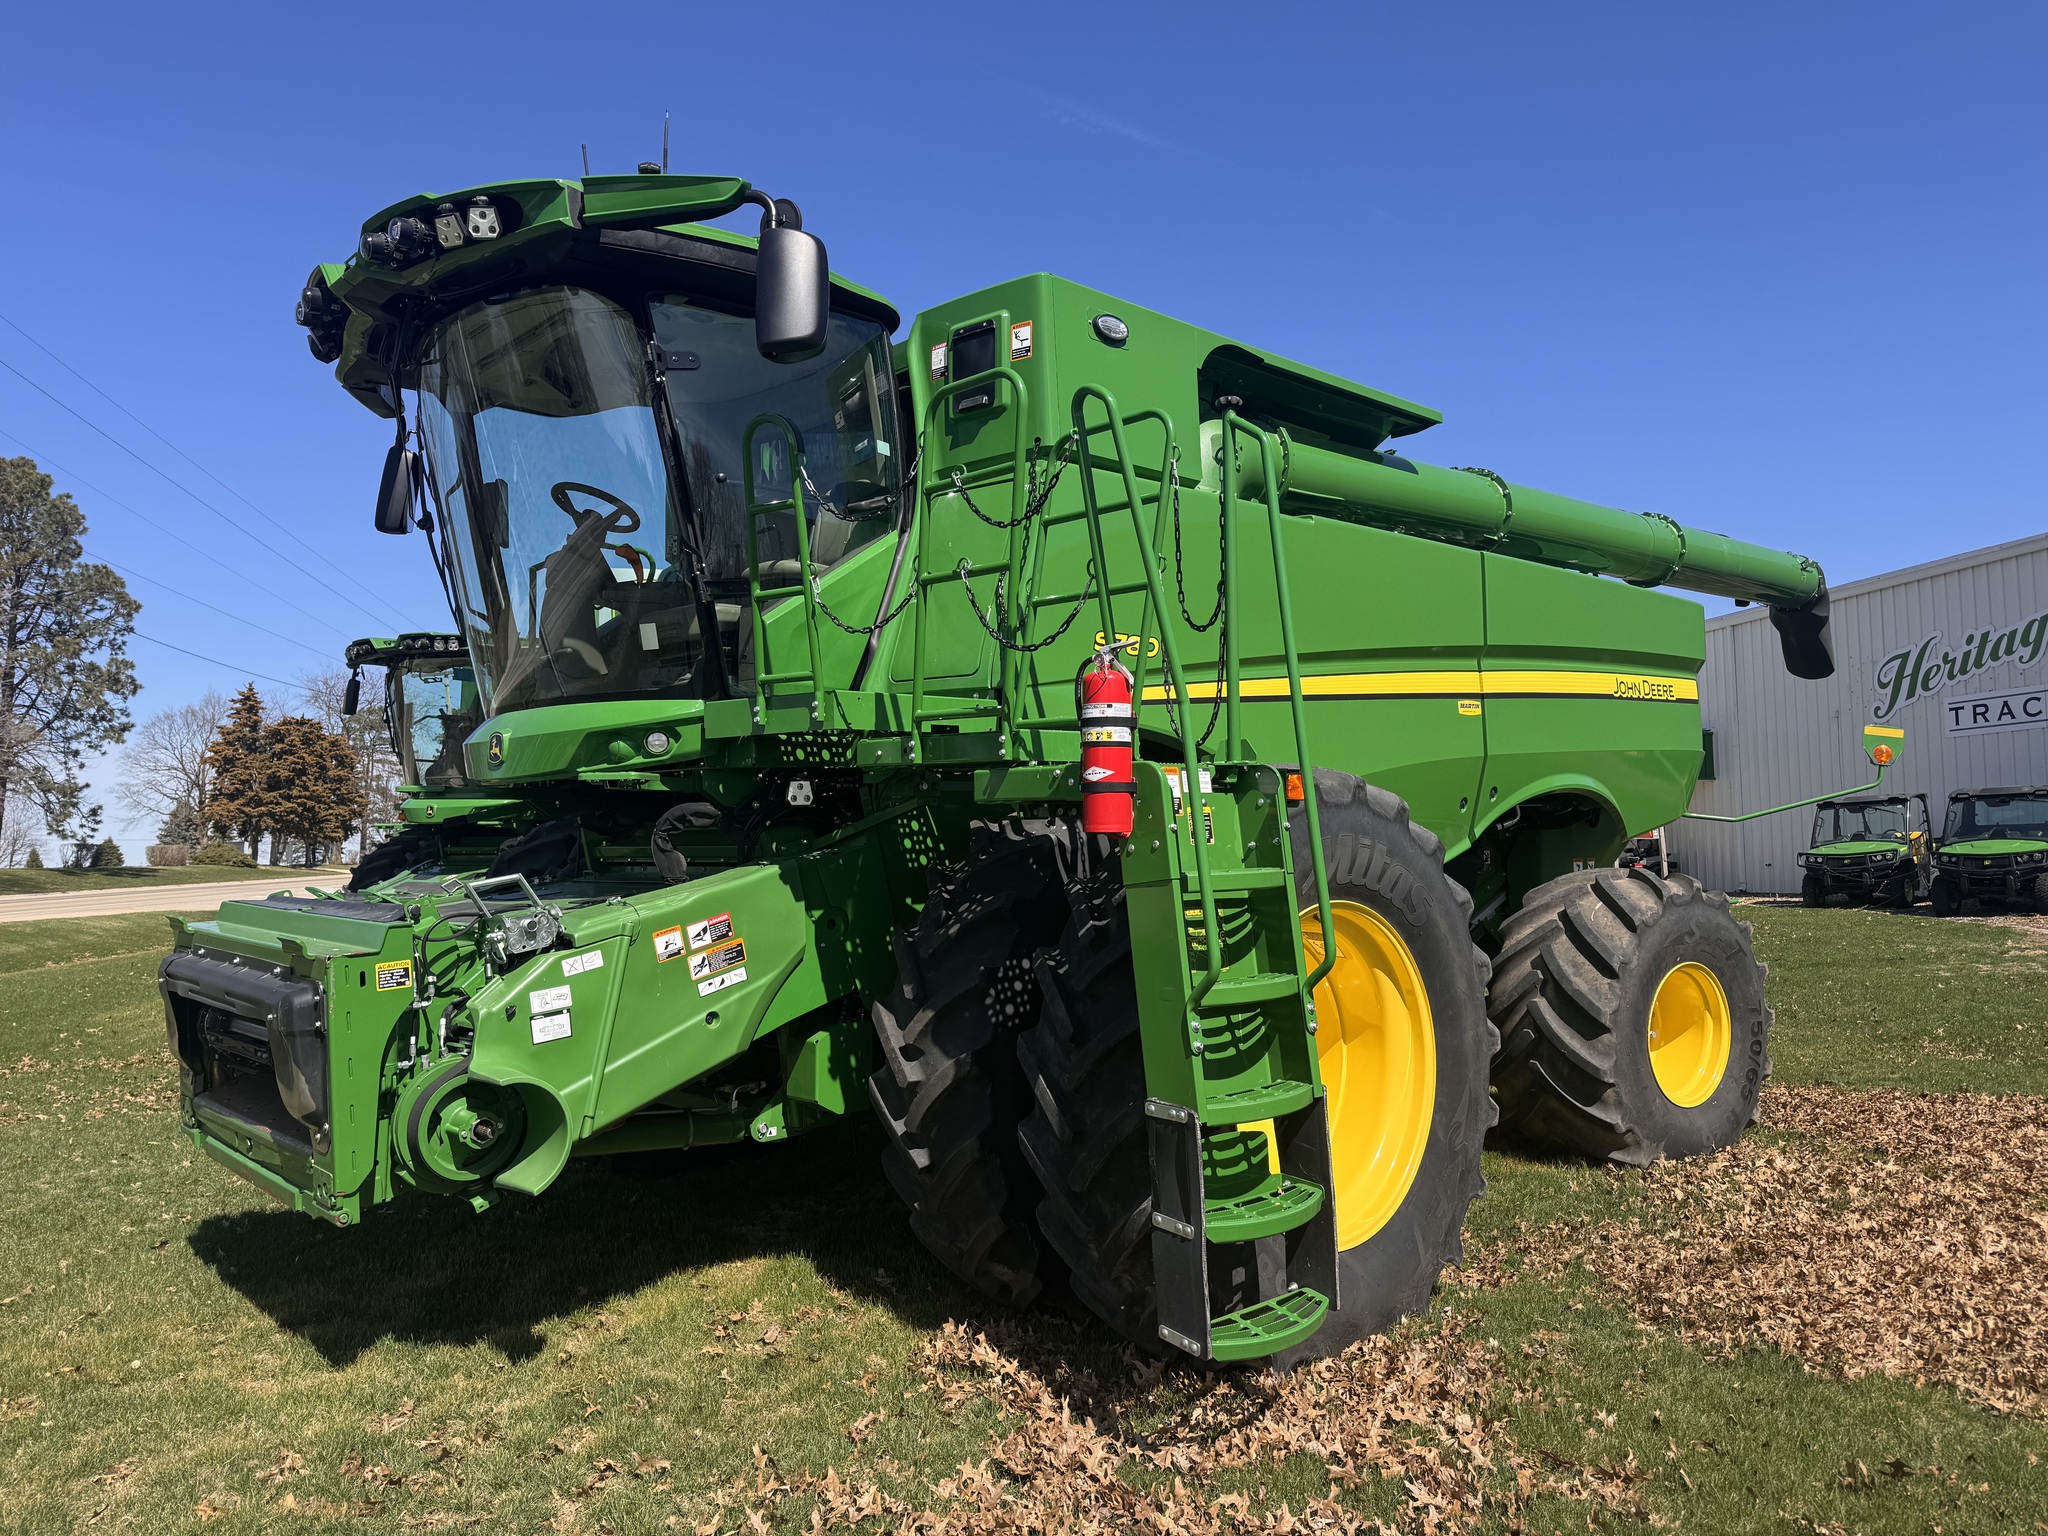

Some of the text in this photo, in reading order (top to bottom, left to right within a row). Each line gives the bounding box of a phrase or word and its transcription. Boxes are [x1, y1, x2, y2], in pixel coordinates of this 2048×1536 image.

[1613, 677, 1675, 698] JOHN DEERE
[1948, 696, 2043, 726] TRAC
[382, 961, 410, 969] CAUTION
[1740, 999, 1764, 1106] 750/65
